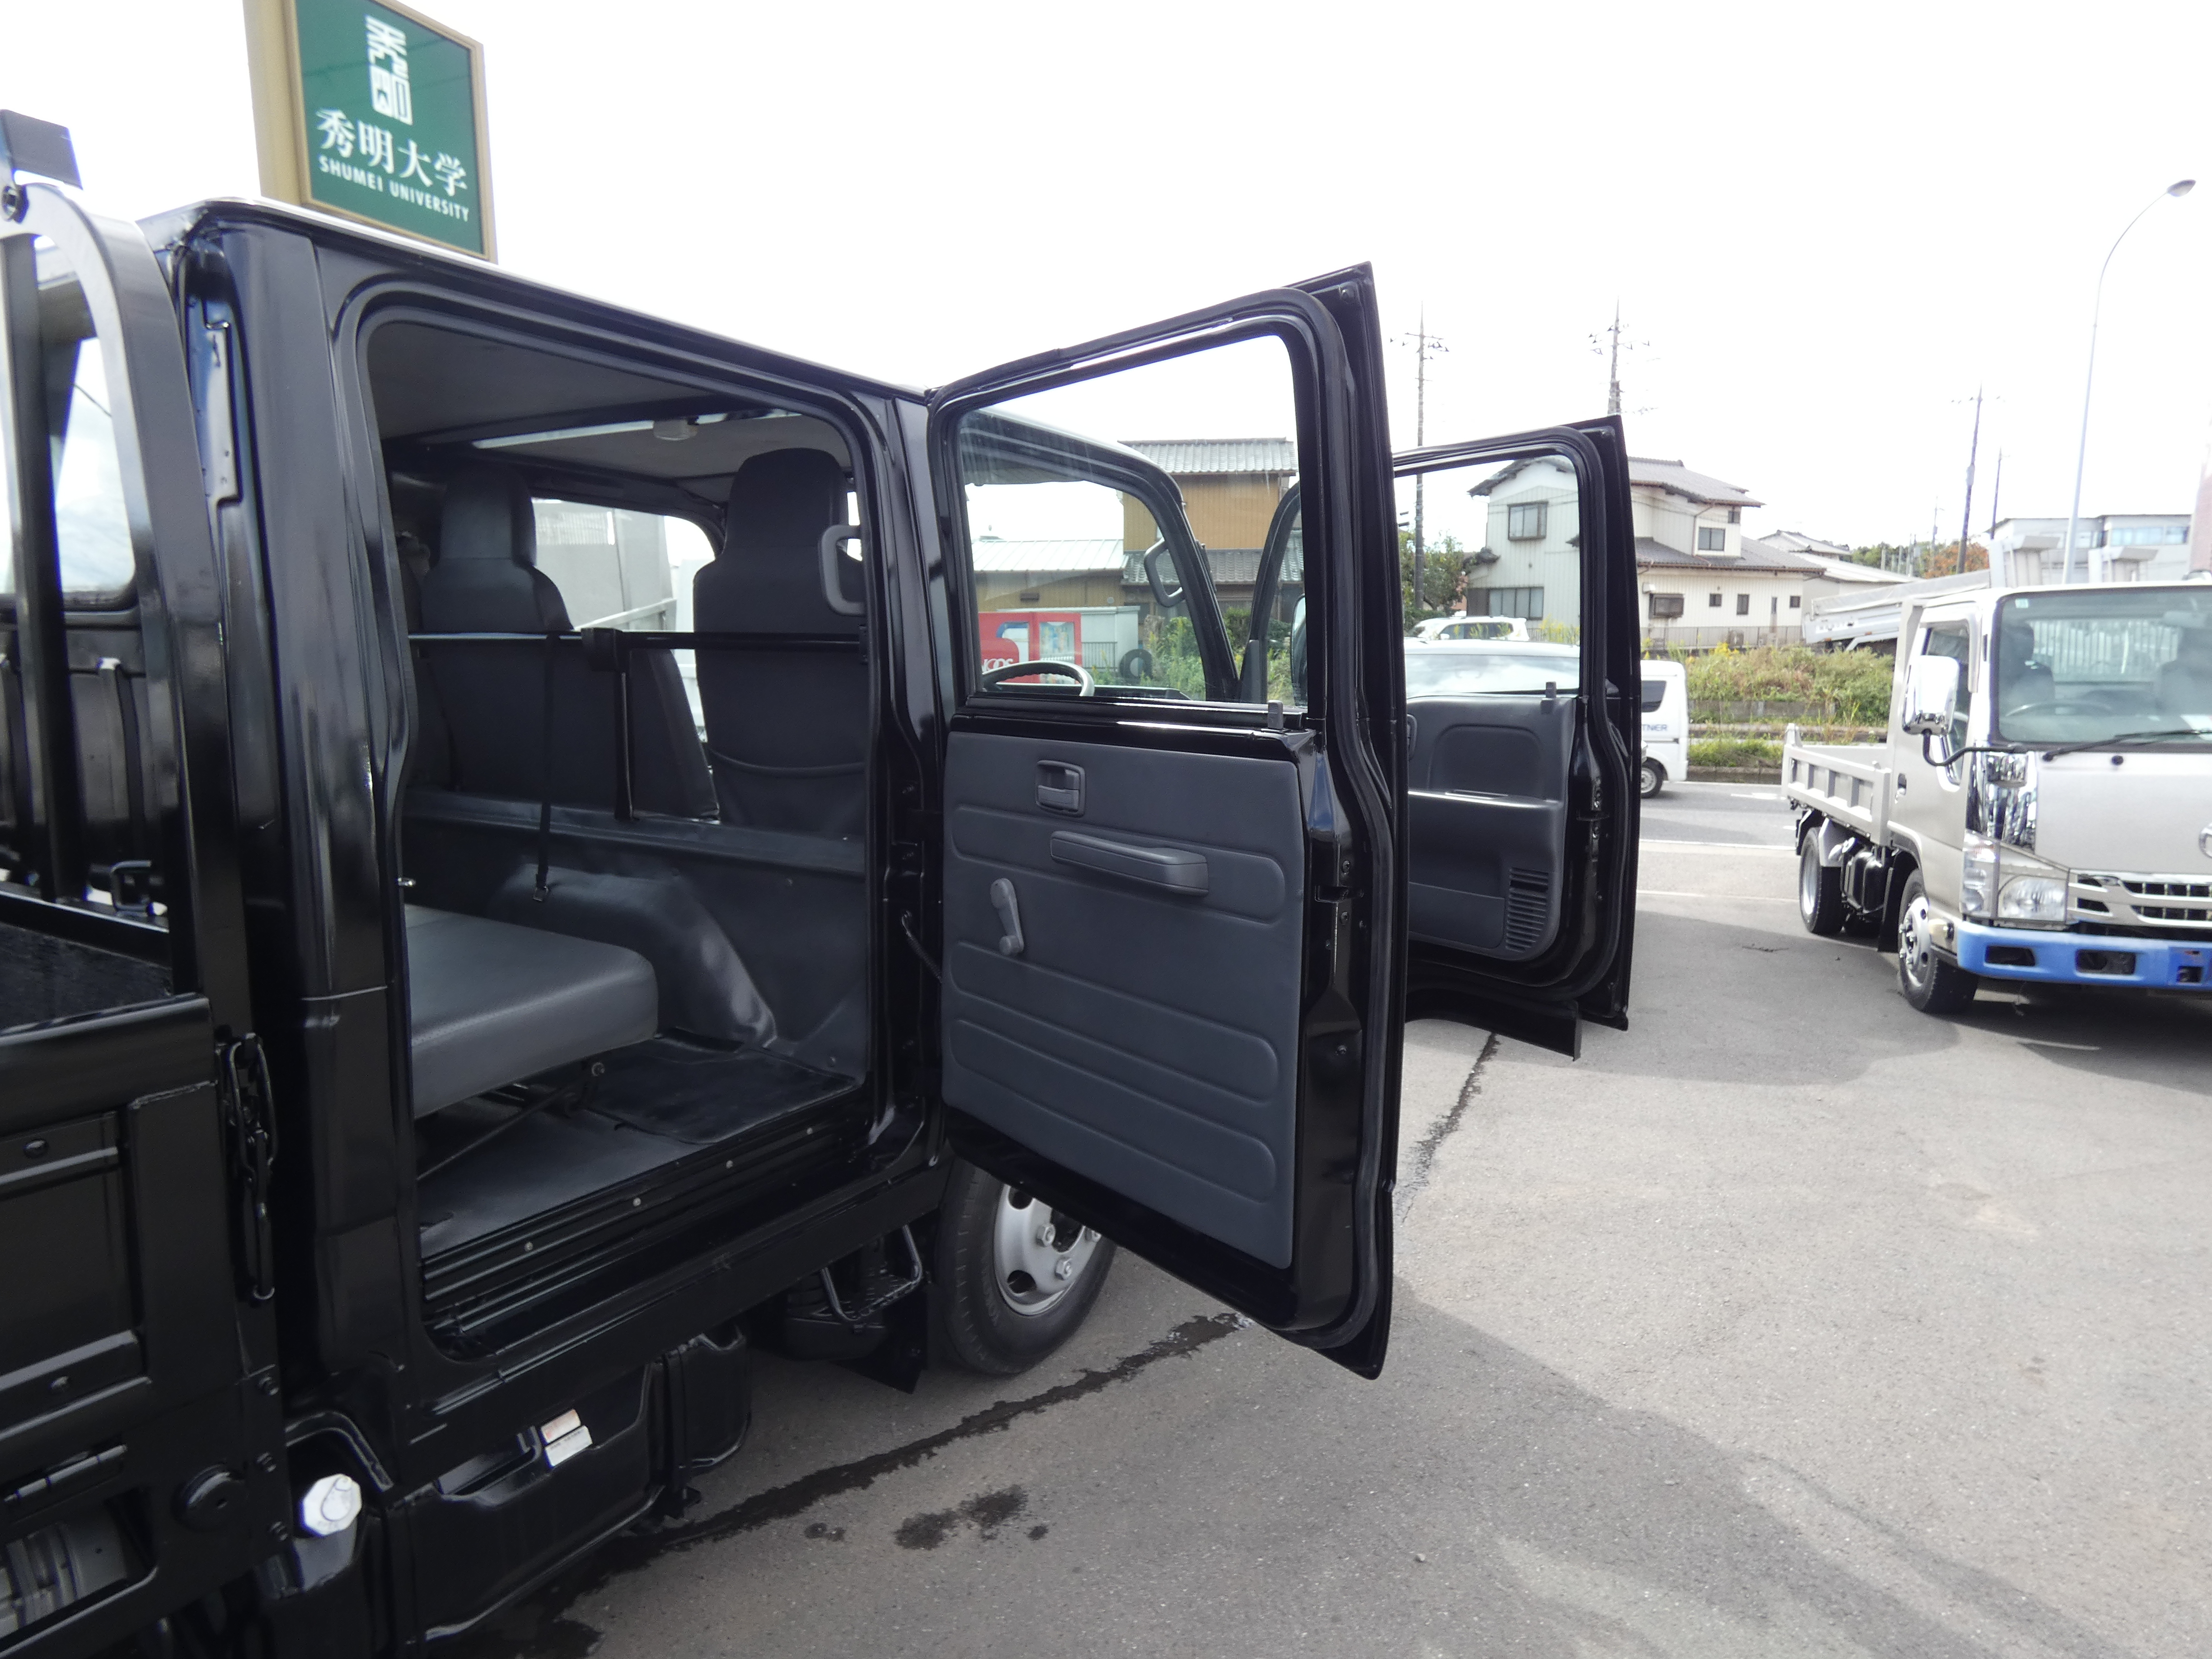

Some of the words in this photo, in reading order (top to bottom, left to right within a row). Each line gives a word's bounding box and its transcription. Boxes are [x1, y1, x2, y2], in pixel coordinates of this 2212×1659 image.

[315, 108, 468, 197] 秀明大学
[318, 155, 383, 192] SHUMEI
[389, 181, 469, 222] UNIVERSITY
